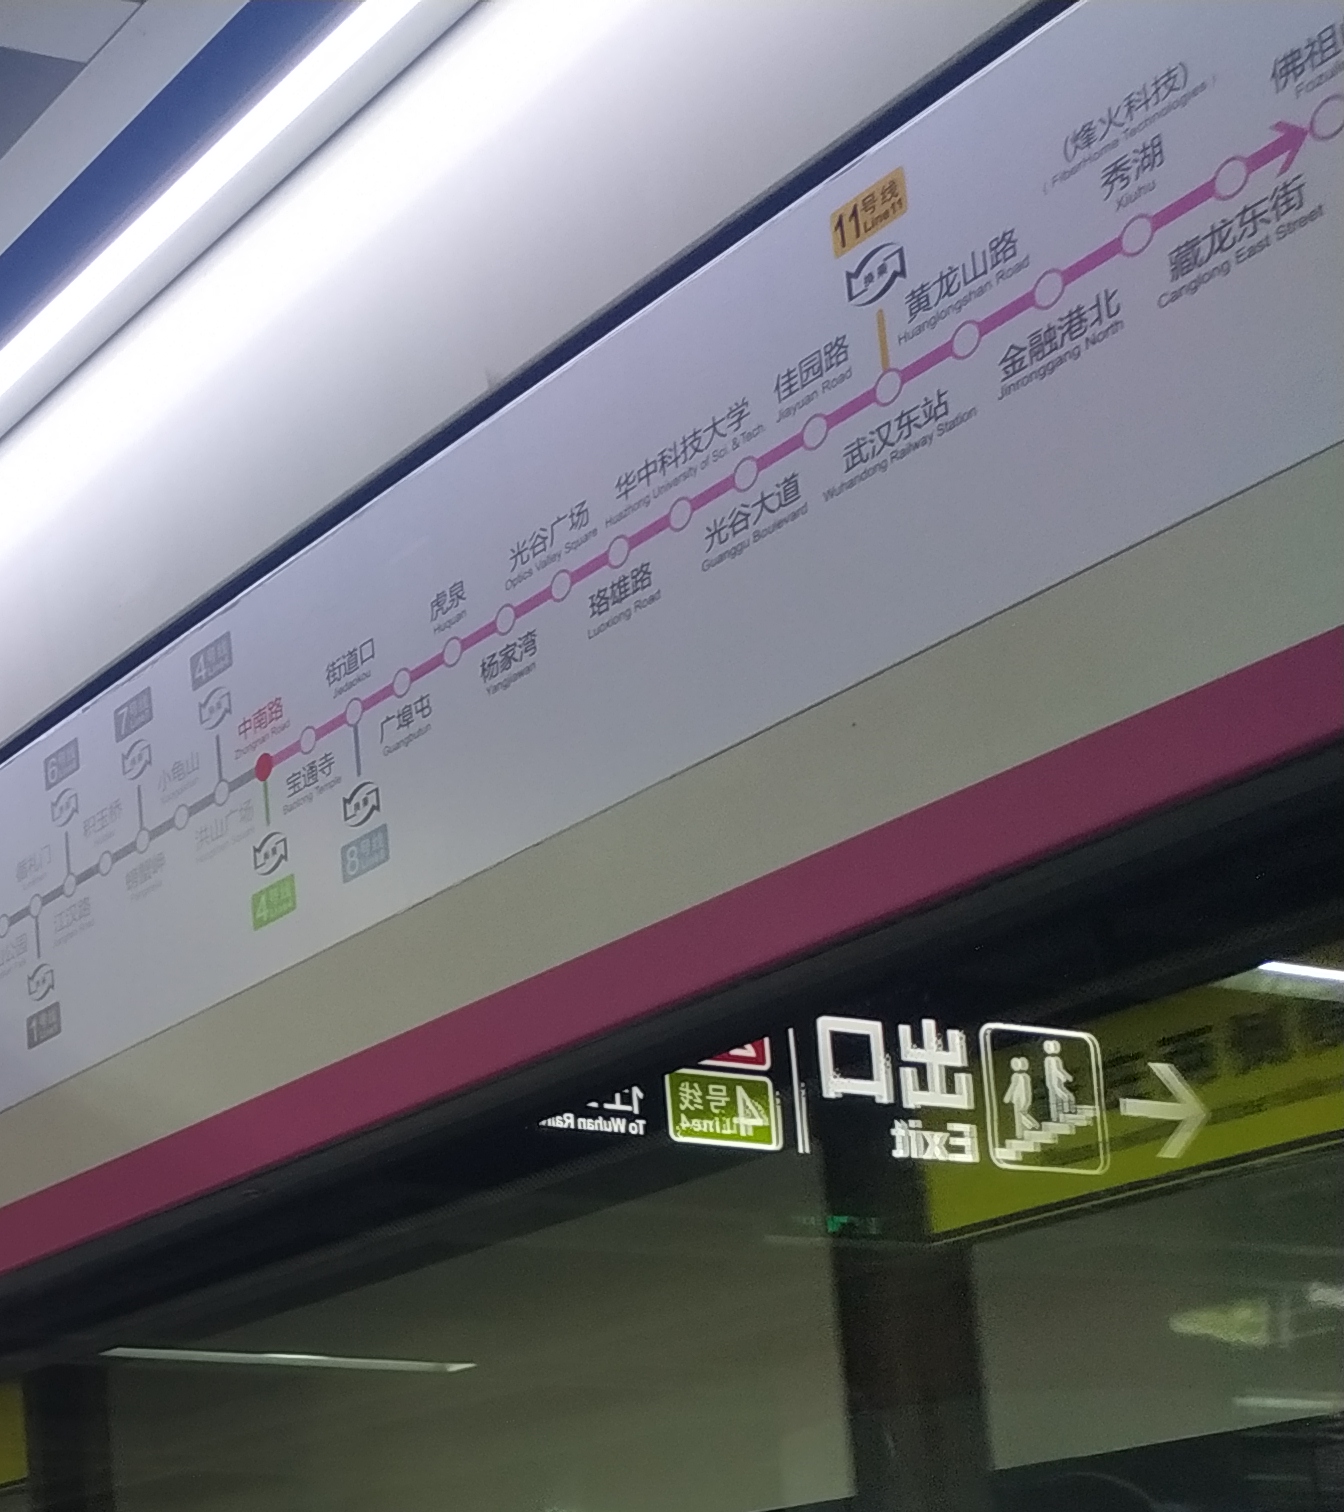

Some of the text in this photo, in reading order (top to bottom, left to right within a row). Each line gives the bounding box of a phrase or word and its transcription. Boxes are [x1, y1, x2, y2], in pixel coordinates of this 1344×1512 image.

[1270, 18, 1344, 94] 佛祖
[1101, 132, 1165, 202] 秀湖
[833, 179, 900, 249] 11号线
[1168, 173, 1307, 283] 藏龙东街
[904, 227, 1019, 325] 黄龙山路
[1156, 203, 1325, 310] Canglong East Street
[897, 252, 1030, 347] Huanglongshan Road
[773, 333, 850, 404] 佳园路
[997, 319, 1126, 401] Jinronggang North
[998, 288, 1121, 383] 金融港北
[775, 366, 853, 424] Jiayuan Road
[615, 397, 751, 500] 华中科技大学
[823, 406, 978, 502] Wuhandong Railway Station
[842, 388, 949, 474] 武汉东站
[652, 466, 698, 499] University
[704, 472, 802, 554] 光谷大道
[509, 499, 590, 573] 光谷广场
[564, 528, 598, 554] Square
[701, 501, 809, 572] Guanggu Boulevard
[430, 580, 467, 622] 虎泉
[588, 562, 653, 618] 珞雄路
[633, 588, 662, 612] Road
[325, 637, 375, 688] 街道口
[479, 628, 538, 684] 杨家湾
[238, 697, 284, 741] 中南路
[379, 693, 433, 744] 广埠屯
[286, 751, 336, 799] 宝通寺
